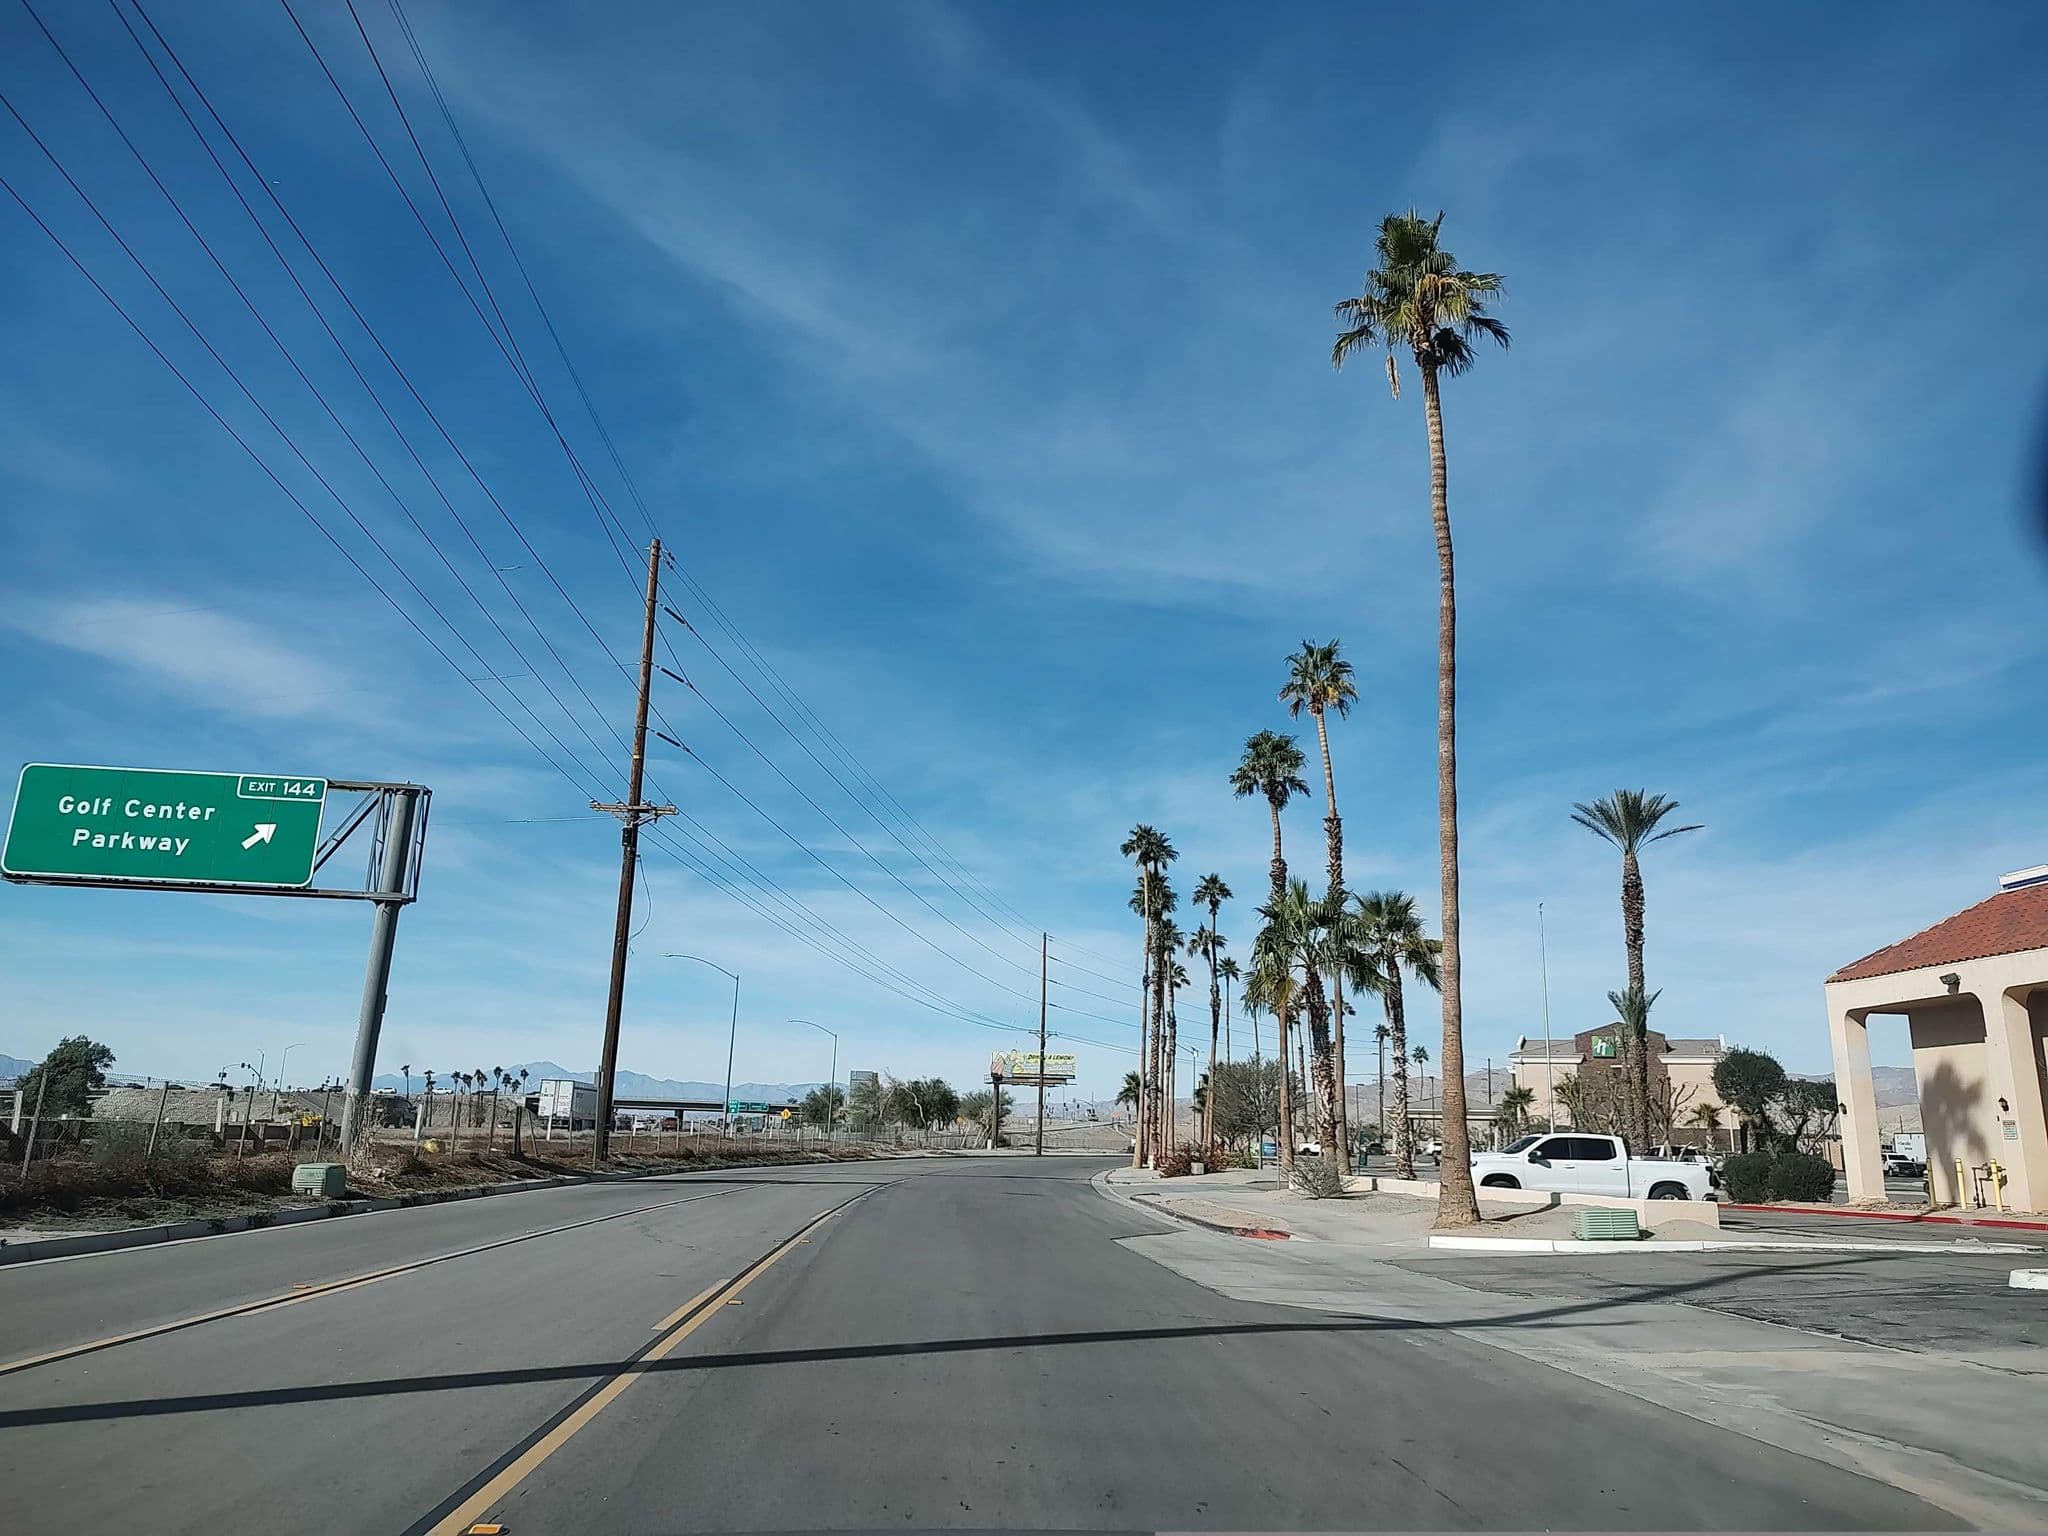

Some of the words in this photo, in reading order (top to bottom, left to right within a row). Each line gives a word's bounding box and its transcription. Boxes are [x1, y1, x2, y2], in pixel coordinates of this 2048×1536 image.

[248, 781, 276, 793] EXIT
[283, 782, 316, 796] 144
[58, 795, 112, 816] Golf
[124, 799, 216, 821] Center
[72, 828, 190, 856] Parkway
